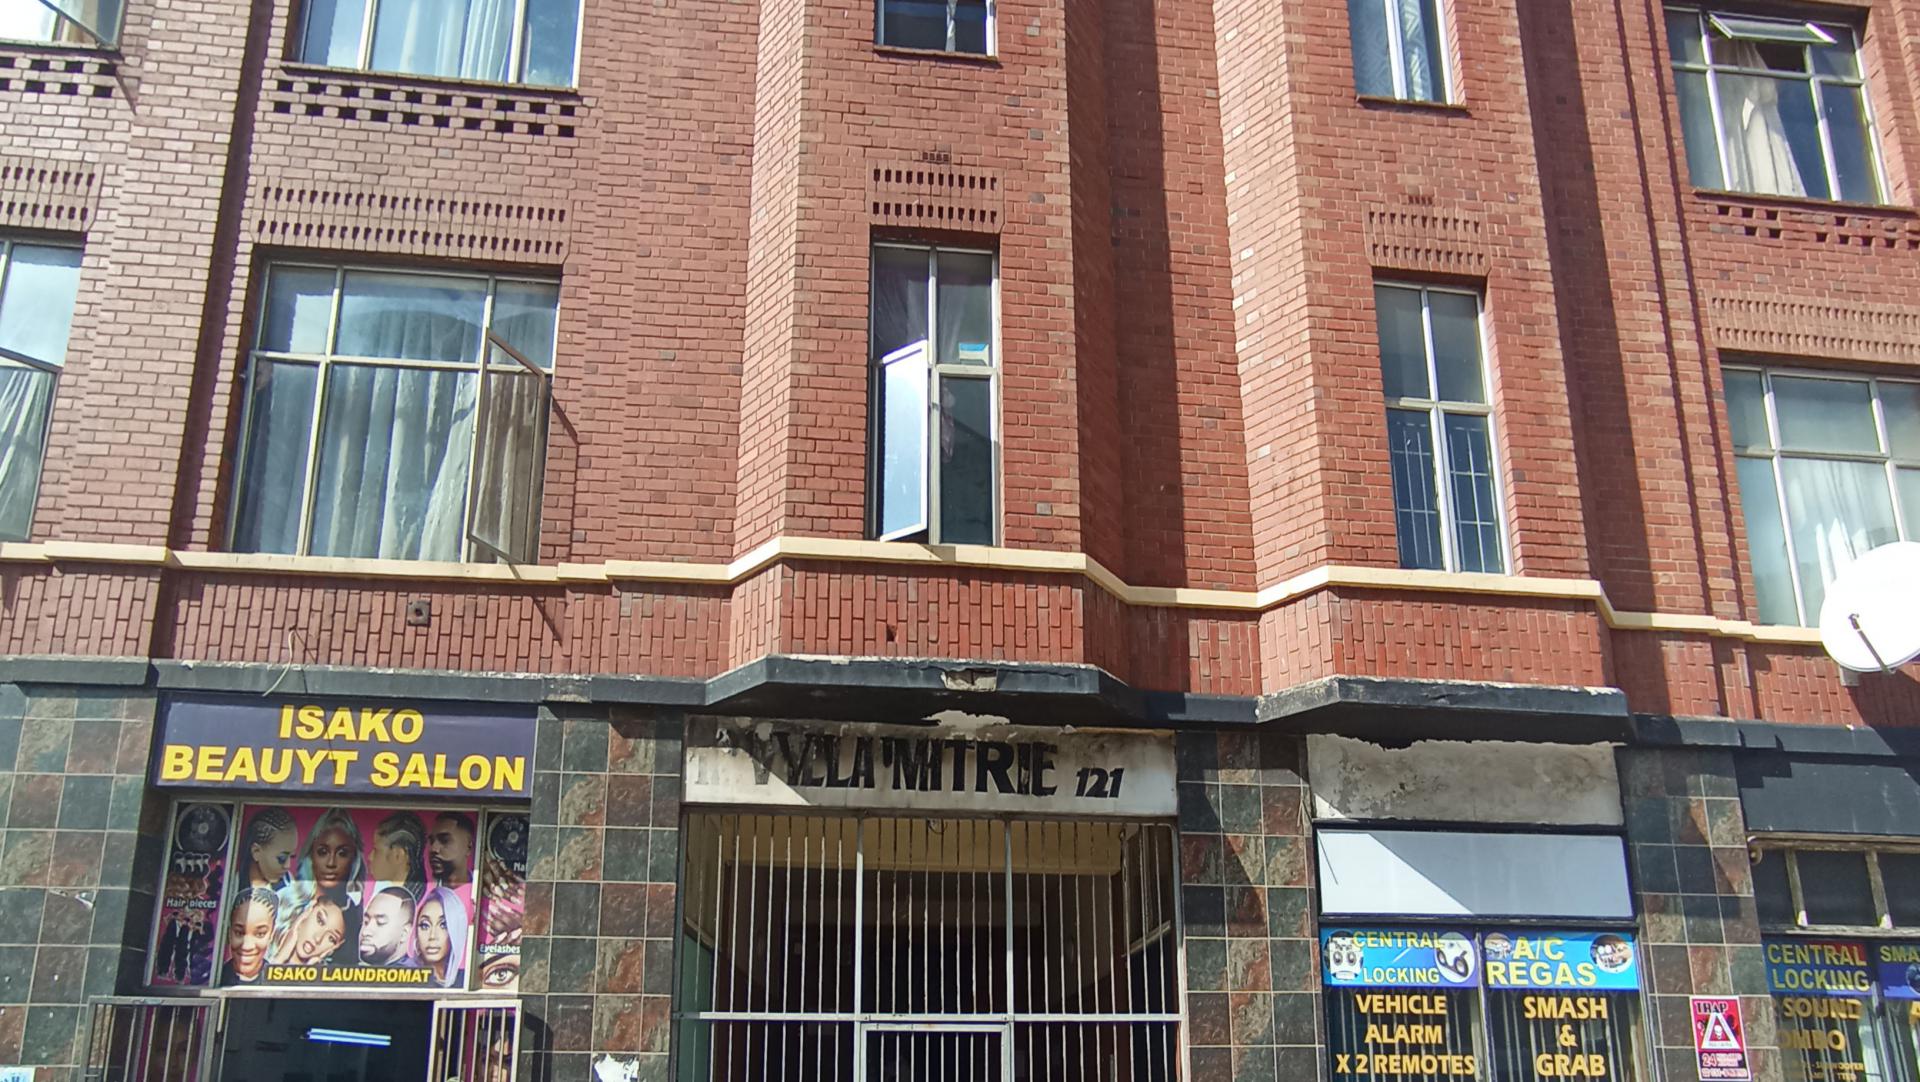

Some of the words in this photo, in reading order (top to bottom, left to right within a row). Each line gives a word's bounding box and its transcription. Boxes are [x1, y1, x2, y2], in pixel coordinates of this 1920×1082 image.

[279, 704, 424, 743] ISAKO
[161, 744, 359, 786] BEAUYT
[370, 751, 525, 792] SALON
[1075, 767, 1124, 798] 121
[166, 898, 186, 908] Hair
[189, 898, 217, 911] pieces
[480, 944, 521, 955] Eyelashes
[1352, 931, 1444, 950] CENTRAL
[1513, 936, 1564, 961] A/C
[1768, 943, 1868, 967] CENTRAL
[267, 967, 318, 981] ISAKO
[321, 967, 432, 983] LAUNDROMAT
[1362, 966, 1440, 984] LOCKING
[1487, 961, 1597, 987] REGAS
[1772, 968, 1870, 992] LOCKING
[1356, 994, 1448, 1015] VEHICLE
[1523, 996, 1608, 1020] SMASH
[1696, 1002, 1728, 1014] TRAP
[1783, 997, 1863, 1020] SOUND
[1364, 1023, 1442, 1045] ALARM
[1558, 1024, 1578, 1048] &
[1336, 1053, 1350, 1074] X
[1355, 1054, 1369, 1074] 2
[1374, 1054, 1475, 1076] REMOTES
[1535, 1053, 1606, 1077] GRAB
[1702, 1054, 1717, 1068] 24
